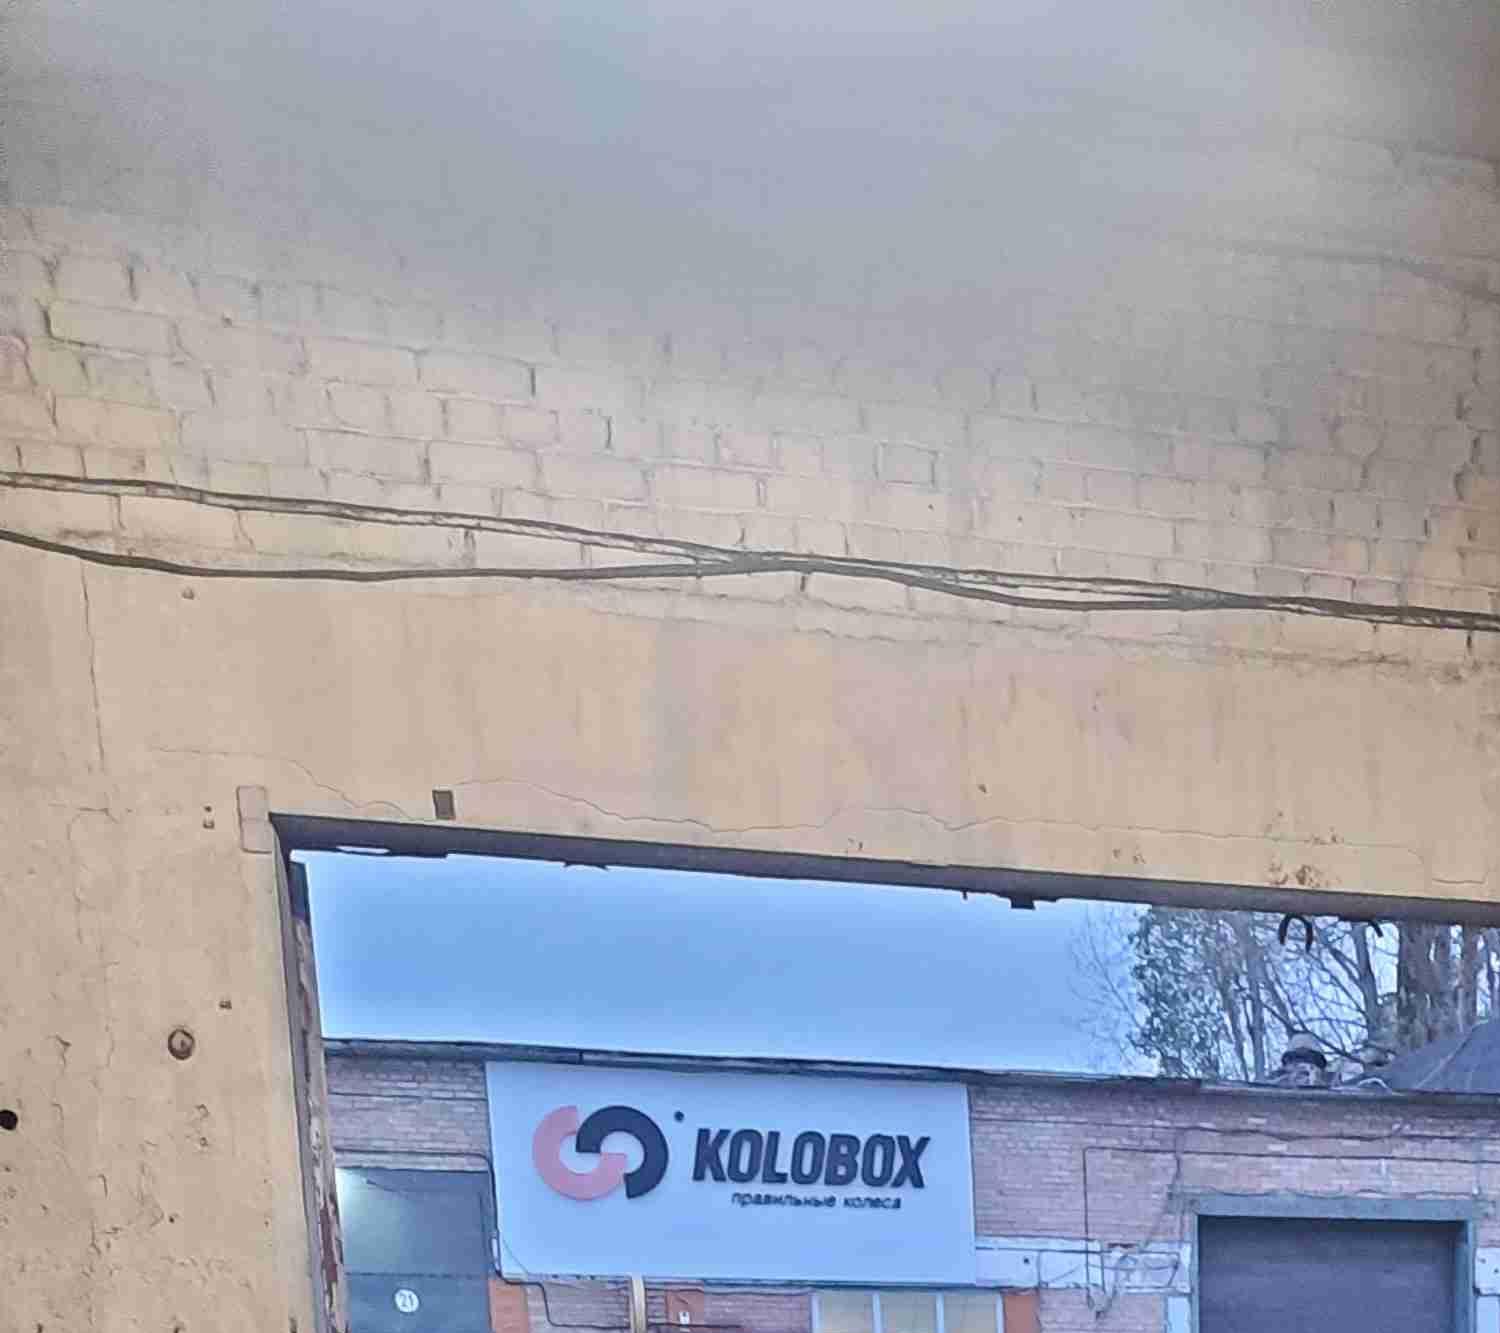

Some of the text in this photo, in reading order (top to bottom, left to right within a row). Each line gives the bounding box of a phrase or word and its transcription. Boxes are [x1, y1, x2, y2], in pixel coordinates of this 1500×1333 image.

[692, 1127, 931, 1189] KOLOBOX
[731, 1192, 902, 1210] правильные колеса
